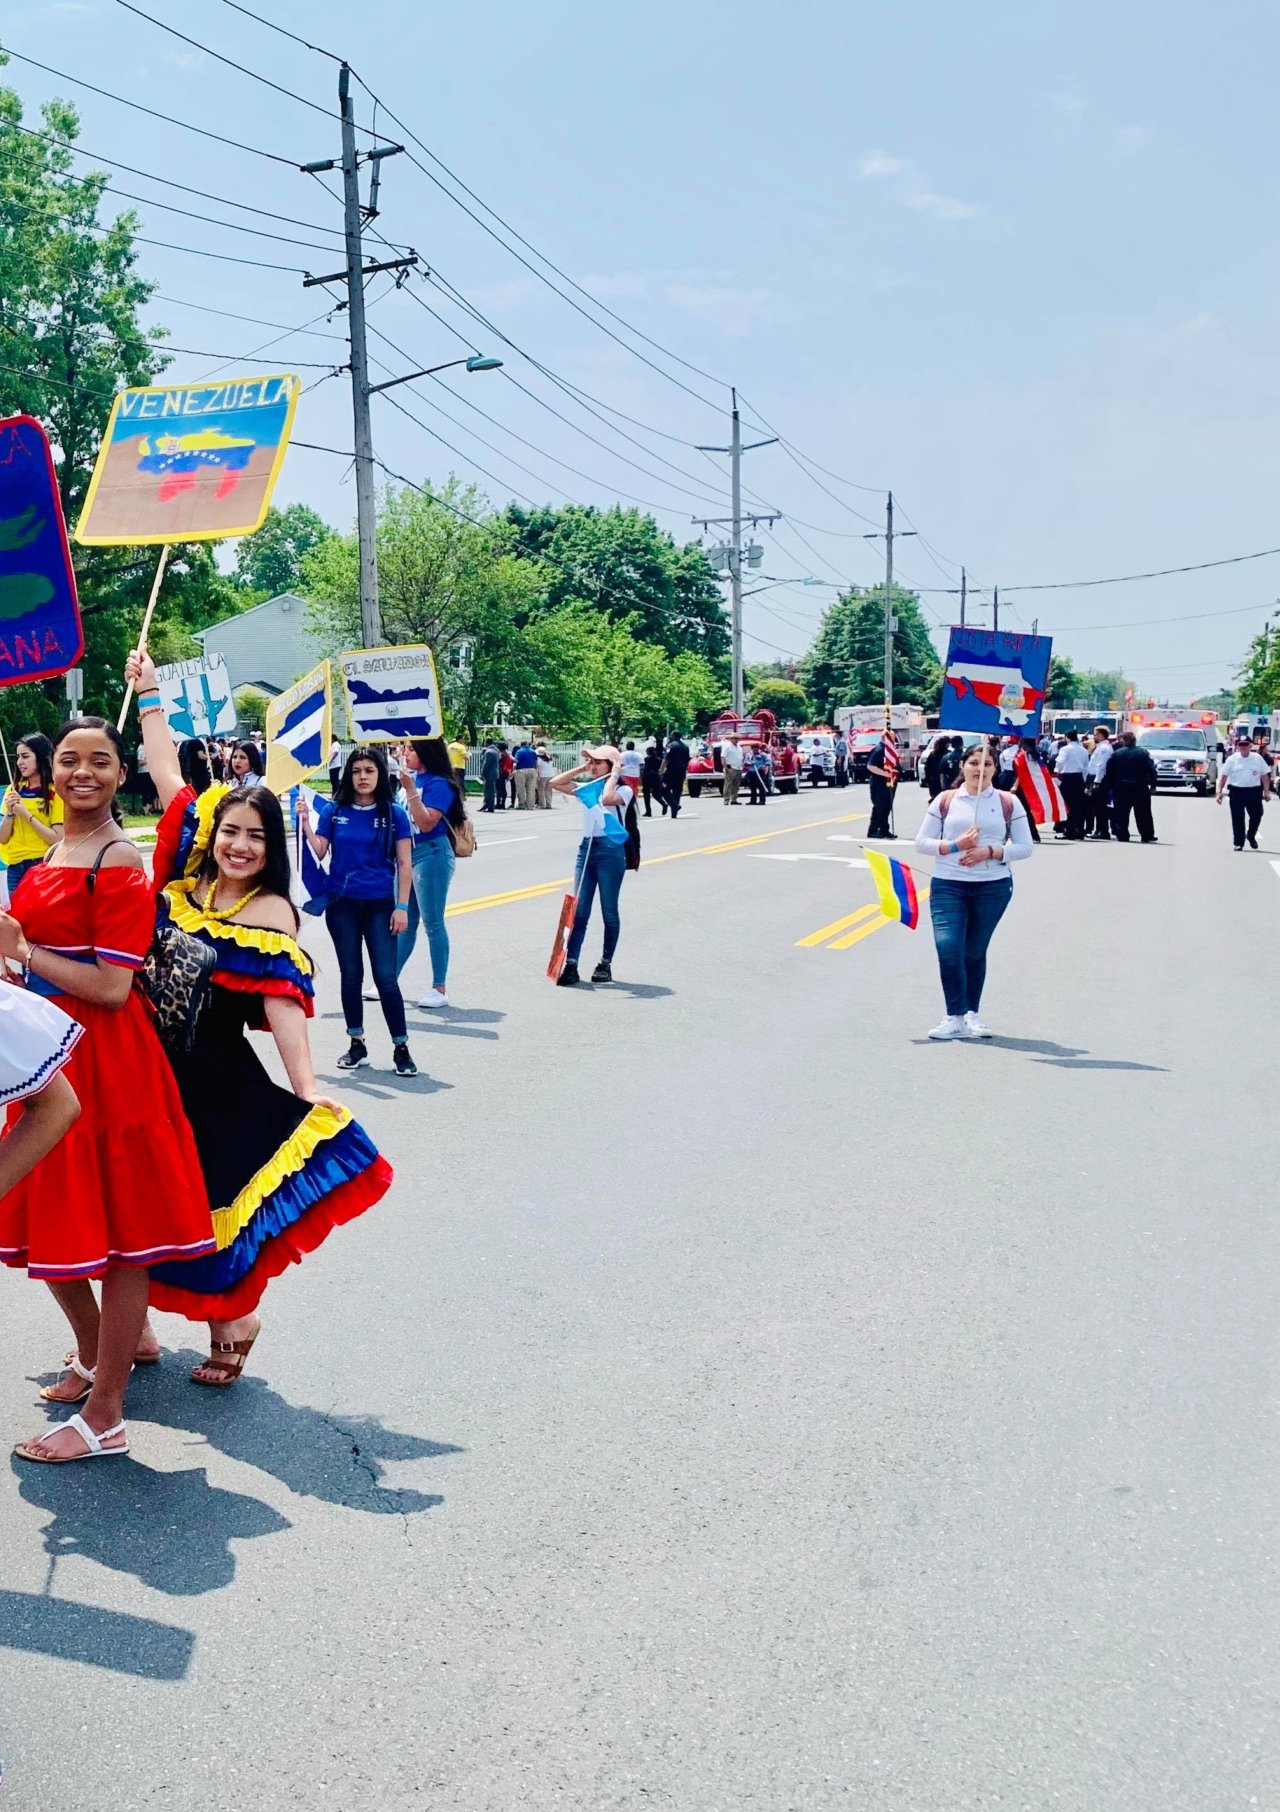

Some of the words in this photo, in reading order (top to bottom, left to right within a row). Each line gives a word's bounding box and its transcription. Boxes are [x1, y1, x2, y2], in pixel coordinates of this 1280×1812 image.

[120, 376, 293, 417] VENEZUELA
[154, 651, 228, 684] GUATEMALA
[343, 661, 361, 676] EL
[363, 653, 430, 674] SALVADOR
